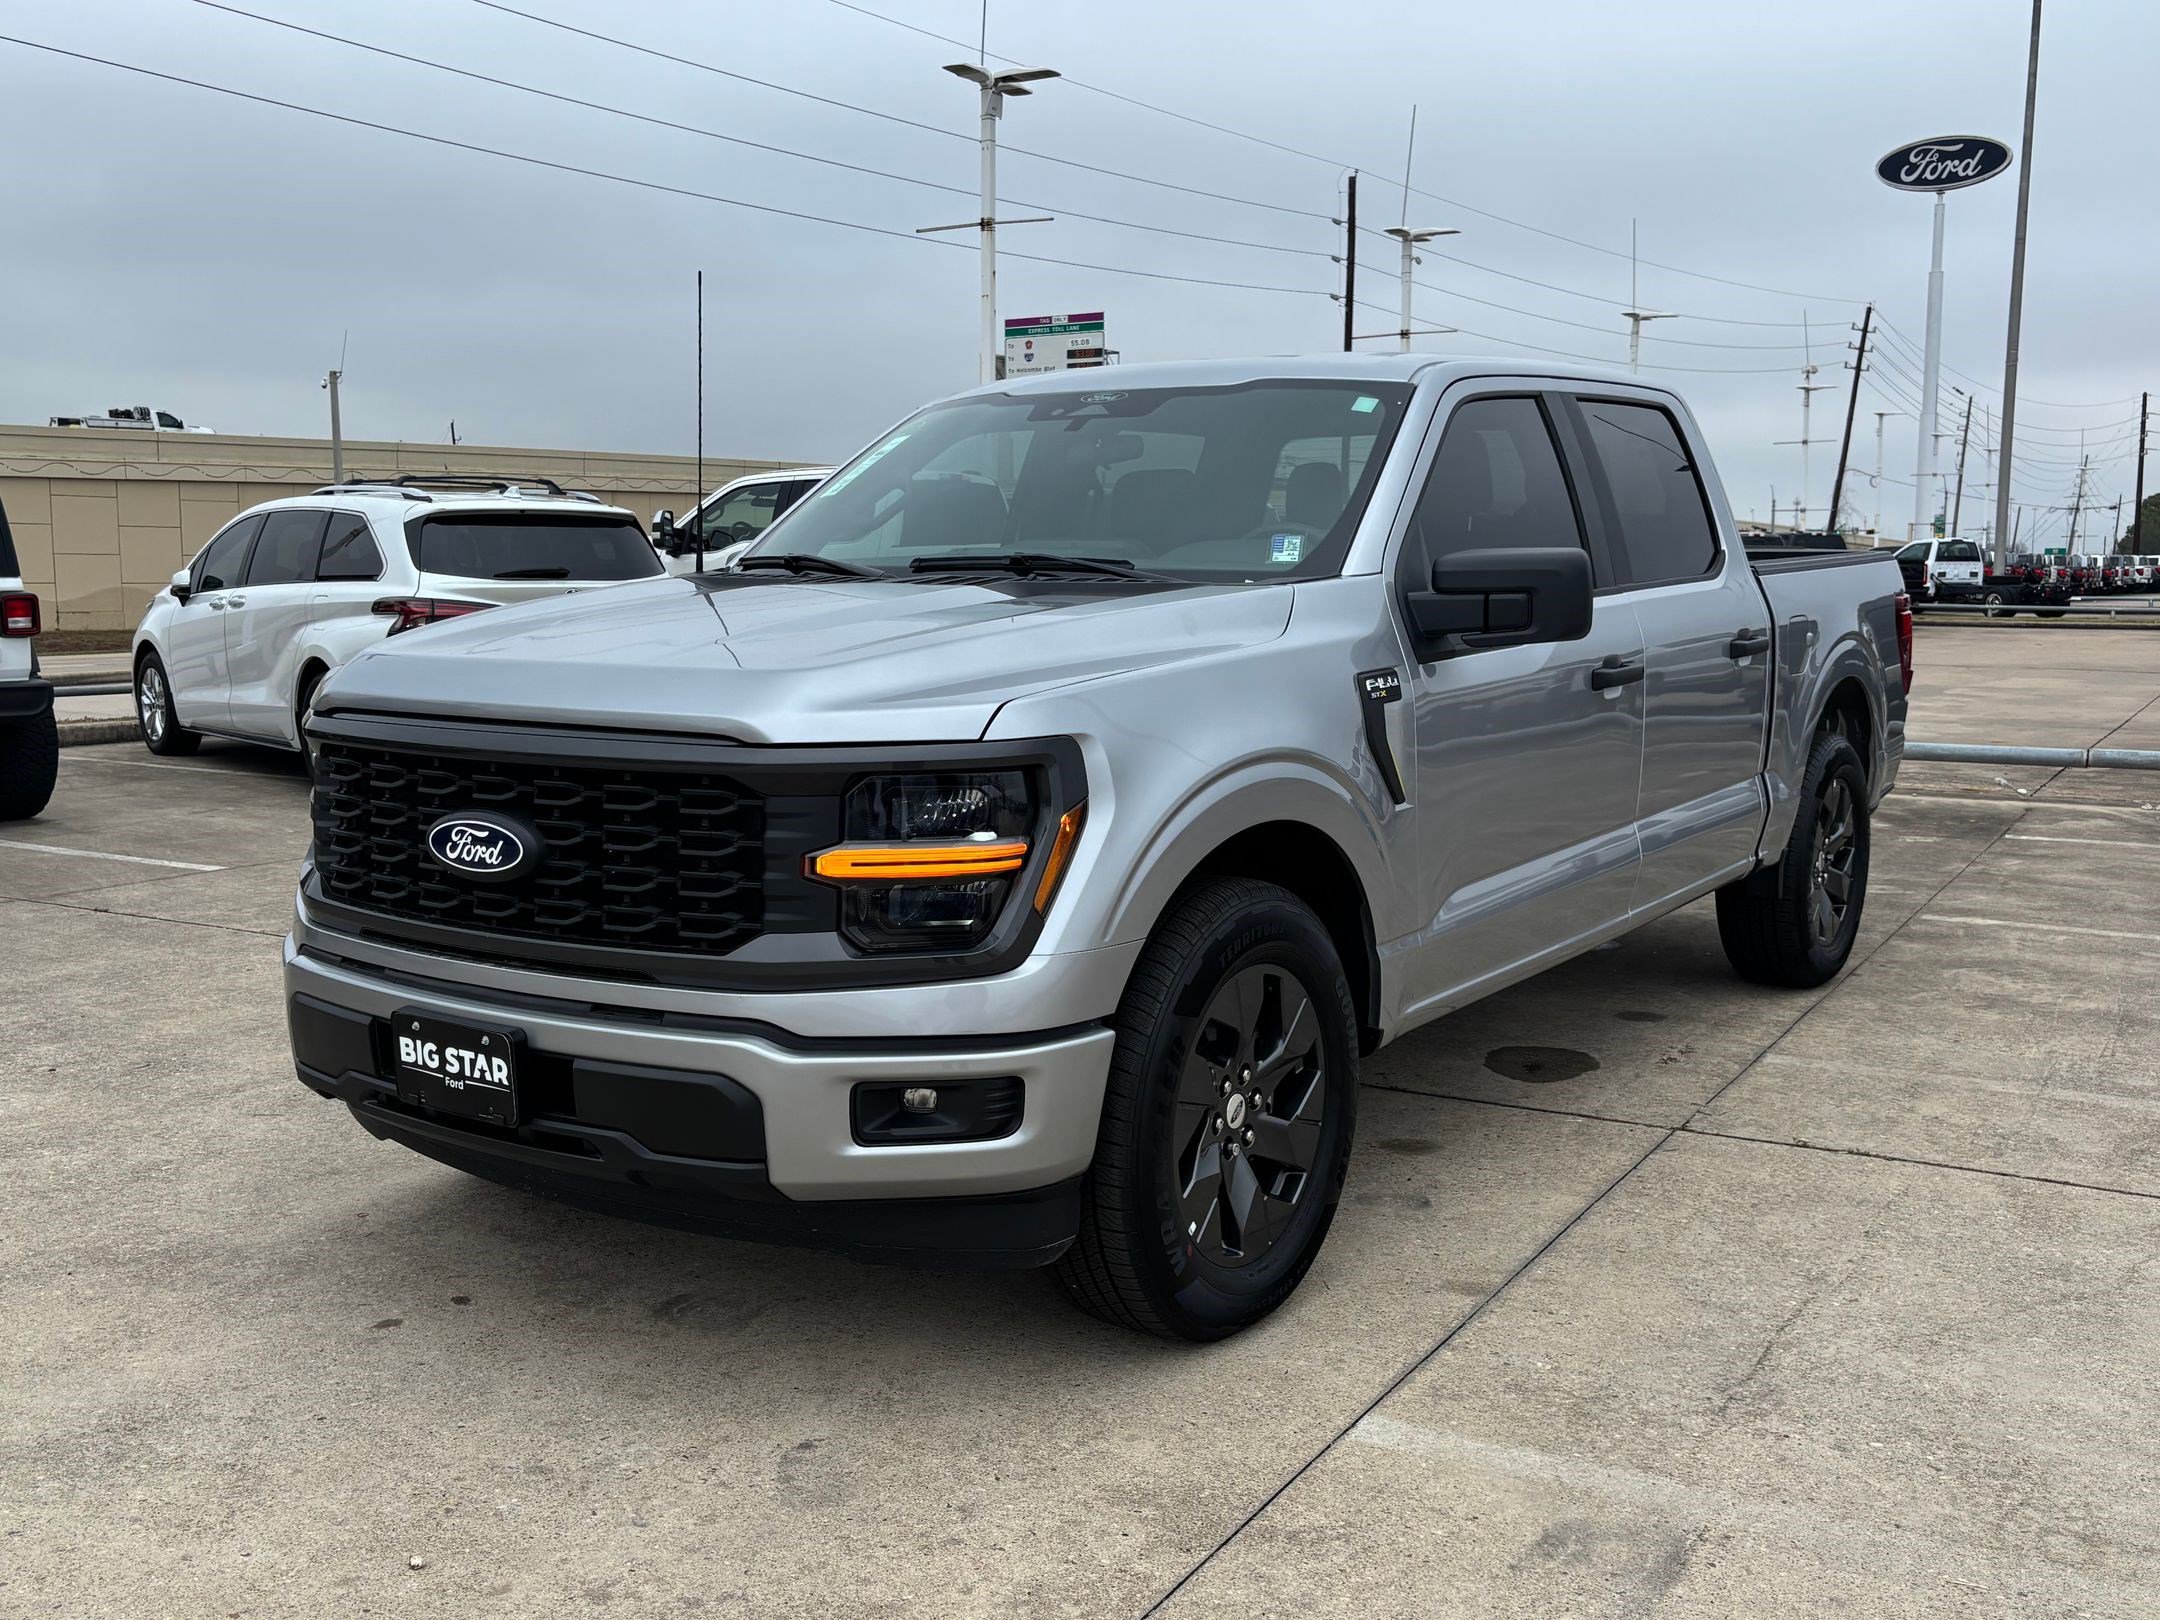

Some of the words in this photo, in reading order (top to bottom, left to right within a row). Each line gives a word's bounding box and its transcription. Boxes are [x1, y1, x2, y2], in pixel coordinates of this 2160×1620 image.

[1900, 143, 1985, 183] Ford
[1371, 690, 1387, 699] STX
[445, 826, 504, 865] Ford
[398, 1036, 440, 1069] BIG
[444, 1046, 510, 1086] STAR
[445, 1076, 464, 1090] Ford
